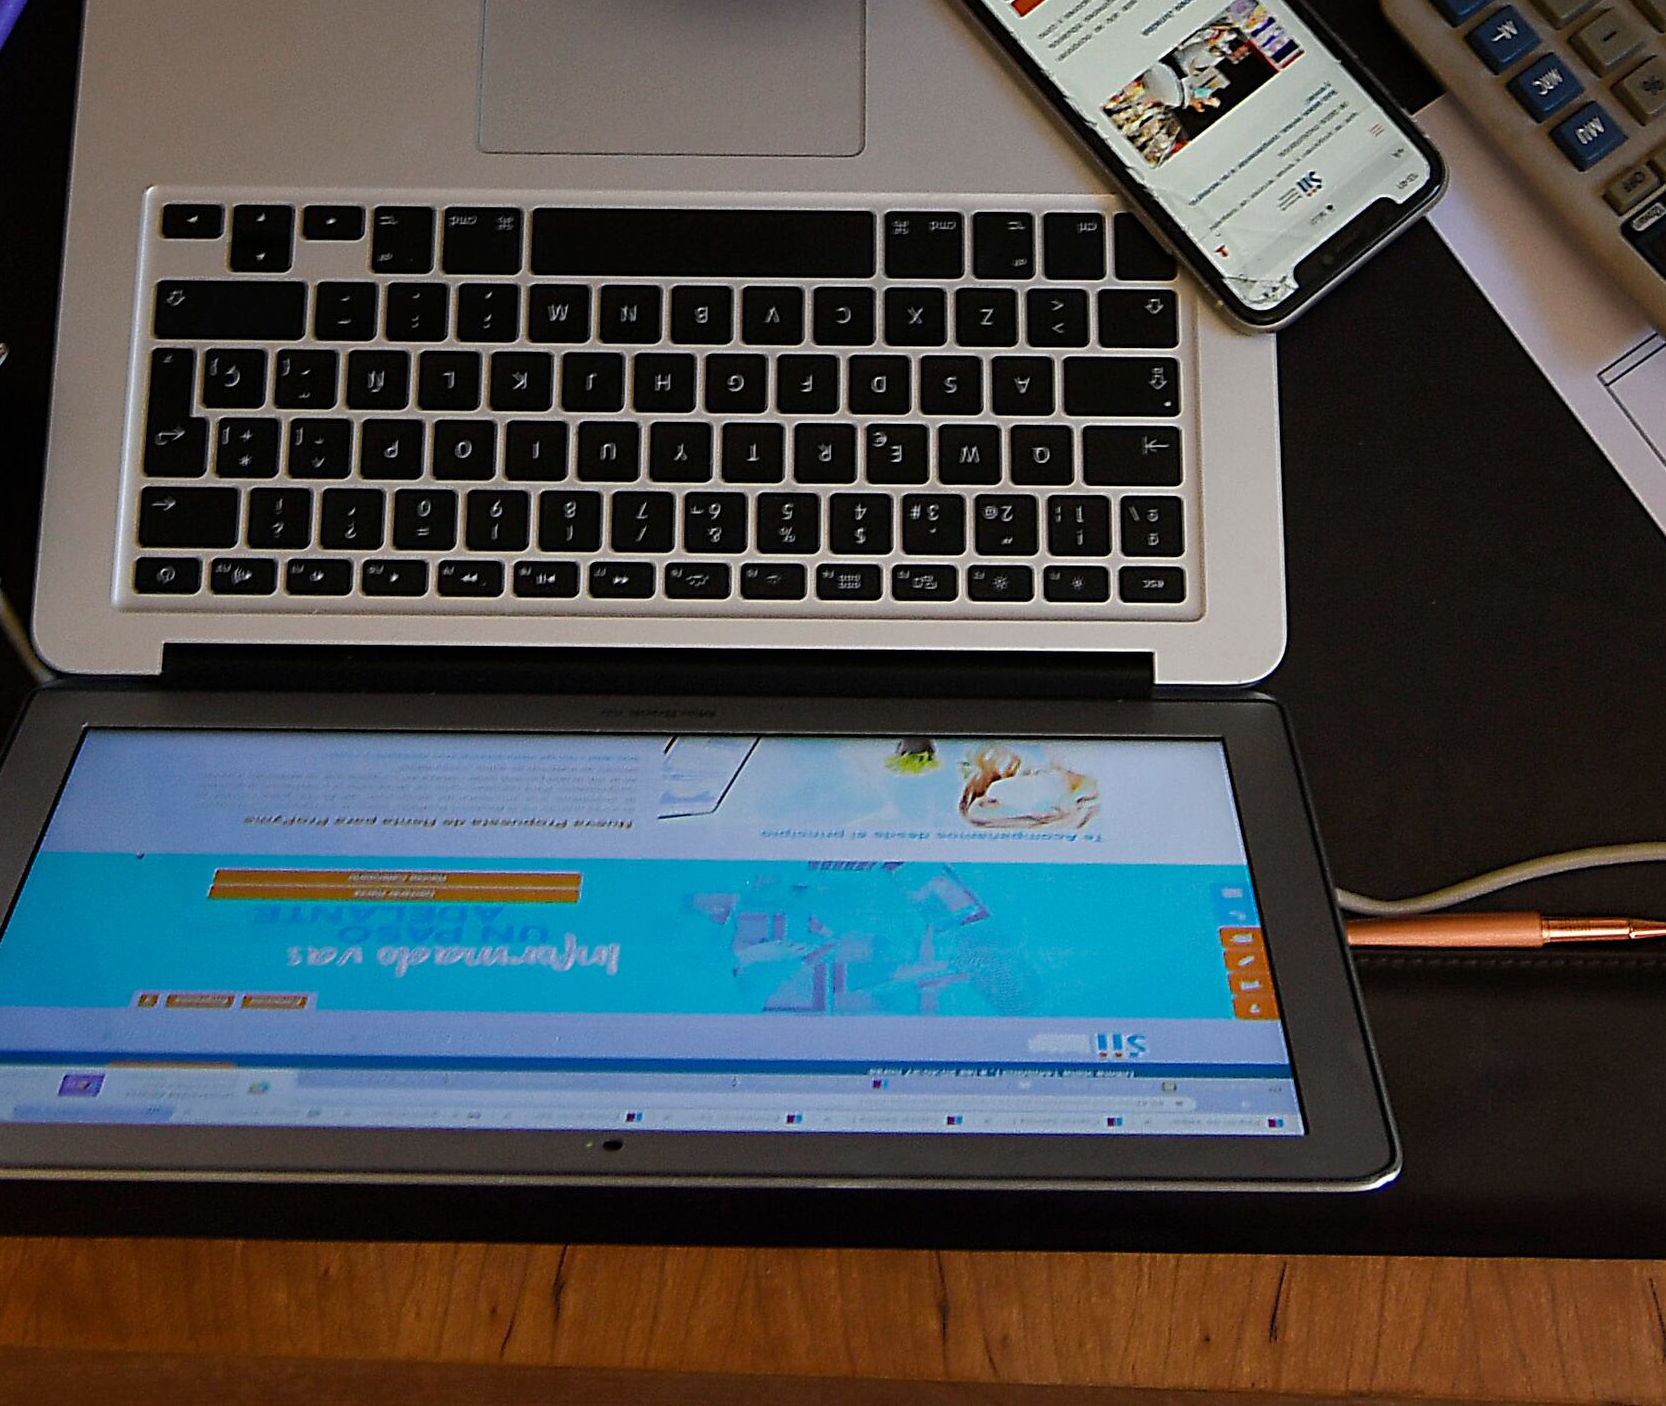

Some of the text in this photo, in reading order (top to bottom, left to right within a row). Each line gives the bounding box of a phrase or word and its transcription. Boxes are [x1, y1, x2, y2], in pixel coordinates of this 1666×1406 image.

[1576, 118, 1603, 143] MU
[548, 304, 568, 320] M
[621, 305, 637, 321] N
[695, 306, 708, 323] B
[765, 306, 779, 322] V
[836, 307, 851, 323] C
[908, 307, 923, 324] X
[980, 308, 993, 324] Z
[443, 371, 454, 388] L
[512, 372, 527, 389] K
[586, 373, 597, 390] J
[655, 374, 671, 390] H
[727, 374, 744, 391] G
[801, 374, 812, 392] F
[871, 376, 886, 392] D
[945, 376, 957, 392] S
[1014, 377, 1030, 393] A
[384, 440, 398, 458] P
[455, 440, 472, 458] O
[600, 442, 616, 459] U
[674, 443, 687, 460] Y
[747, 443, 759, 461] T
[818, 444, 831, 461] R
[891, 445, 902, 462] E
[960, 446, 979, 462] W
[1033, 446, 1050, 463] Q
[253, 905, 504, 923] ADELANTE
[336, 924, 463, 943] PASO
[286, 932, 618, 976] Informado vas
